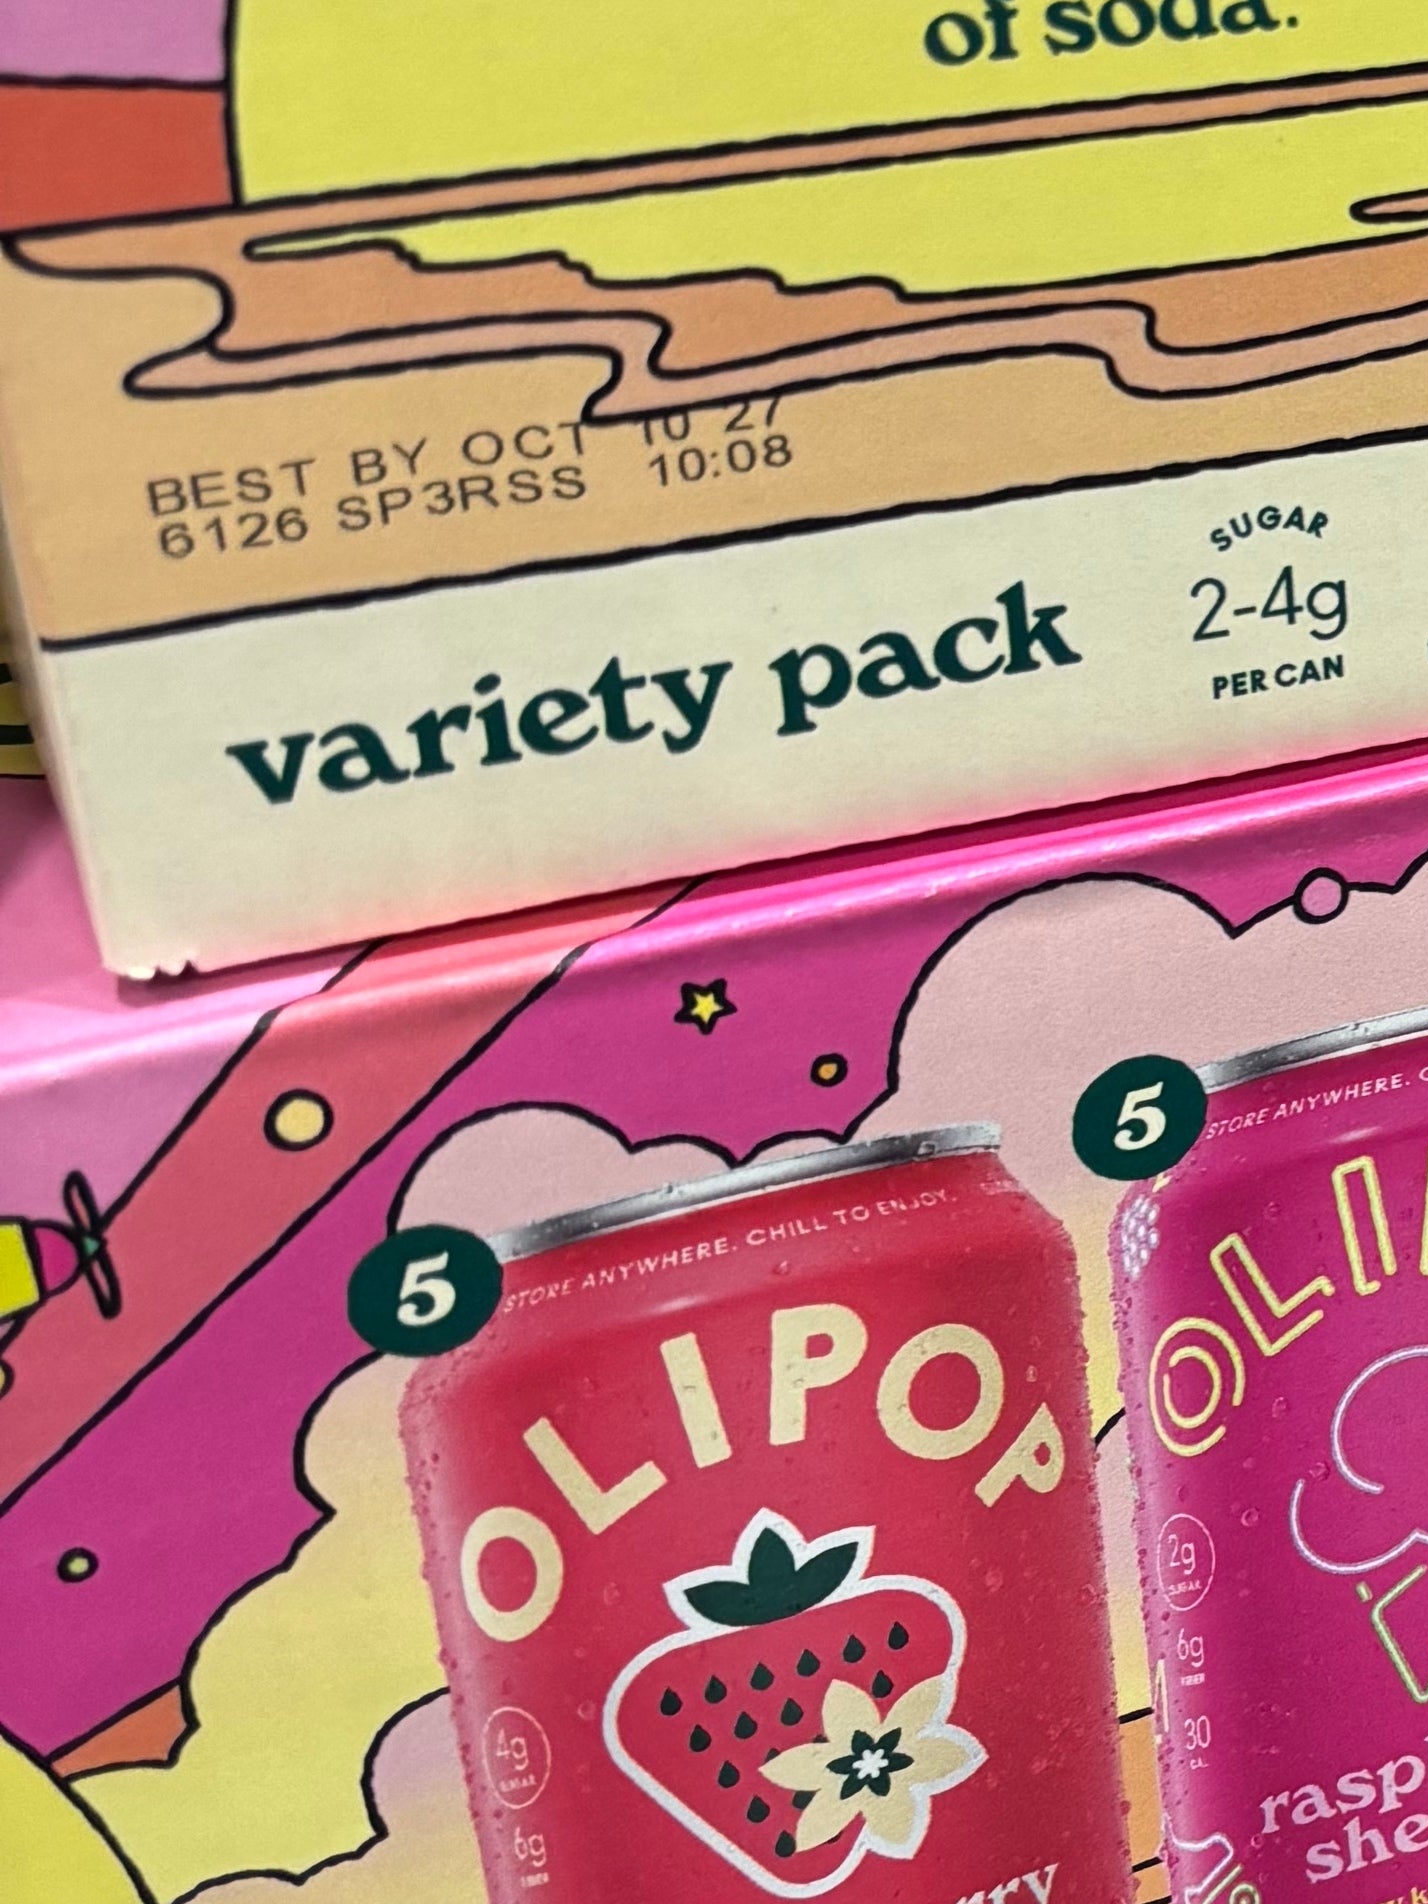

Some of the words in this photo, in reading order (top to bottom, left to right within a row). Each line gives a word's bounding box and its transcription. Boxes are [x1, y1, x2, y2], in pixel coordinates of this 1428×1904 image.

[148, 458, 316, 518] BEST
[351, 437, 429, 488] BY
[462, 421, 586, 466] OCT
[725, 396, 783, 434] 27
[158, 508, 309, 560] 6126
[337, 465, 587, 533] SP3RSS
[648, 434, 794, 488] 10:08
[1210, 506, 1329, 553] SUGAR
[1190, 565, 1348, 642] 2-4g
[226, 657, 732, 804] variety
[769, 580, 1083, 736] pack
[1212, 666, 1267, 700] PER
[1274, 655, 1345, 690] CAN
[1113, 1082, 1166, 1151] 5
[397, 1250, 457, 1328] 5
[504, 1275, 573, 1312] STORE
[745, 1218, 828, 1248] CHILL
[832, 1205, 870, 1224] TO
[460, 1303, 1066, 1644] OLIPOP
[1167, 1534, 1195, 1576] 2g
[1177, 1629, 1204, 1668] 6g
[1185, 1716, 1211, 1750] 30
